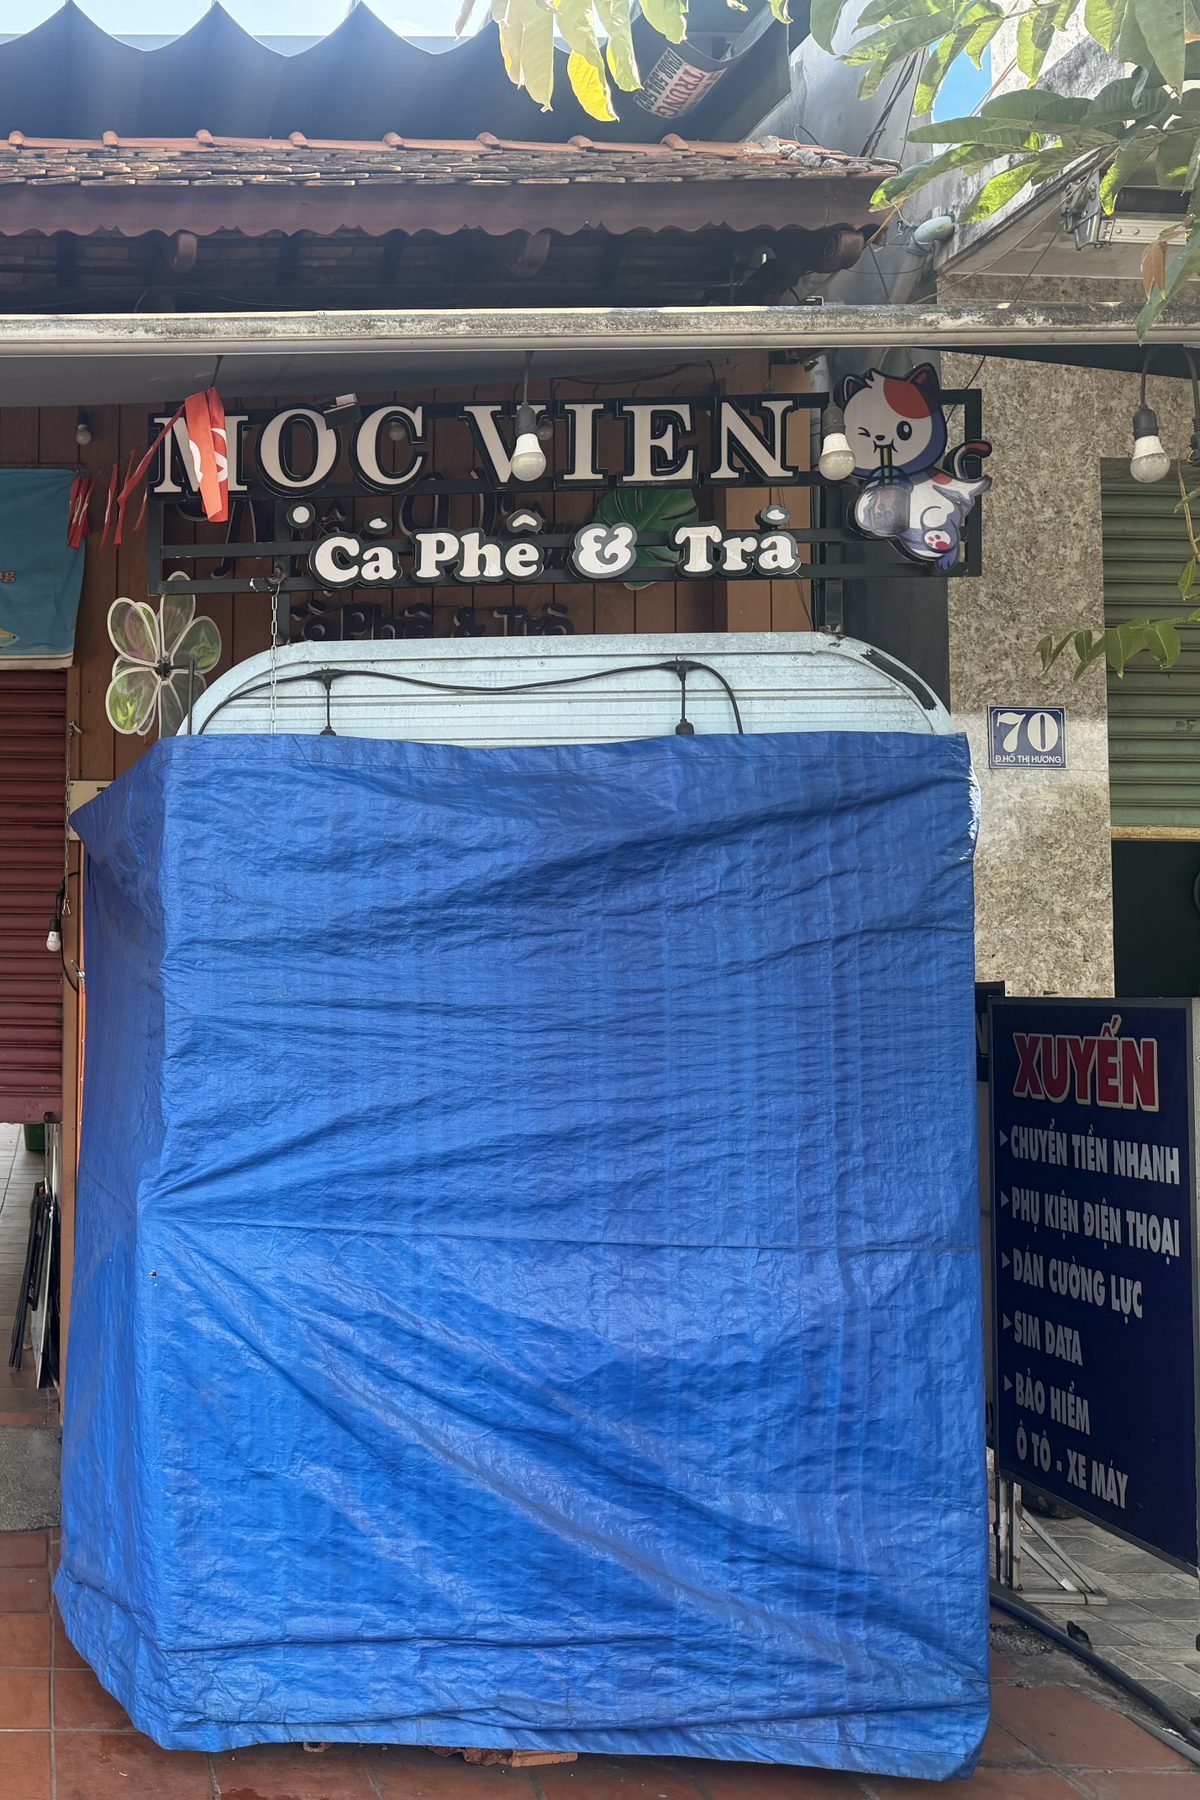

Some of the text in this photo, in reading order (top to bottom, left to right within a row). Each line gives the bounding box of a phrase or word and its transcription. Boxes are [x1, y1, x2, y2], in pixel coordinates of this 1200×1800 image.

[655, 69, 706, 118] TRUNG
[416, 514, 540, 578] Phê
[579, 526, 633, 574] &
[996, 712, 1059, 753] 70
[1013, 1015, 1159, 1112] XUYẾN
[1011, 1118, 1180, 1185] CHUYỂN TIỀN NHANH
[1012, 1186, 1180, 1265] PHỤ KIỆN ĐIỆN THOẠI
[1013, 1244, 1143, 1324] DÁN CƯỜNG LỰC
[1014, 1310, 1083, 1366] SIM DATA
[1015, 1368, 1090, 1435] BẢO HIỂM
[1016, 1419, 1028, 1461] Ô
[1031, 1430, 1051, 1472] TÔ
[1066, 1448, 1087, 1490] XE
[1091, 1459, 1128, 1509] MÁY
